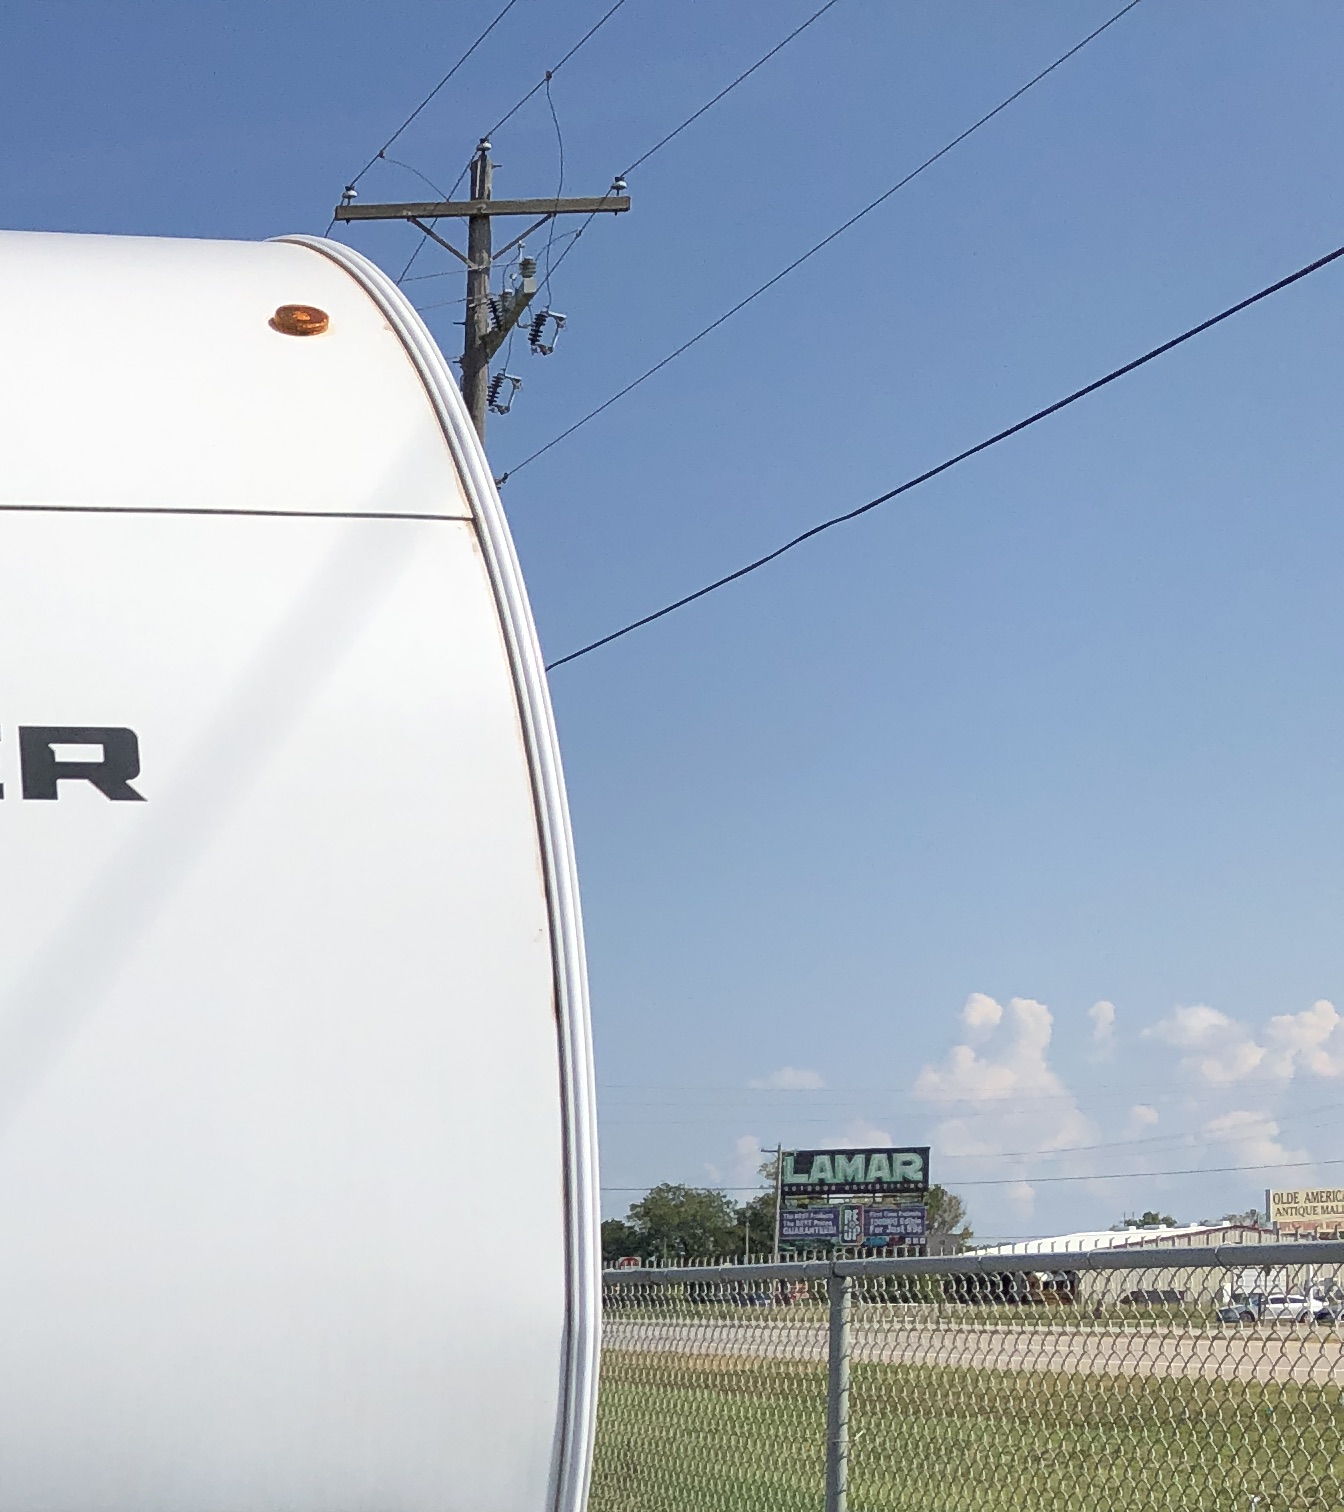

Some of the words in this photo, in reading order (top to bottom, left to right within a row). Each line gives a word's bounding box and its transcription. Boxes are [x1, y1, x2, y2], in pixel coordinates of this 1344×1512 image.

[784, 1153, 924, 1183] LAMAR
[1273, 1192, 1300, 1205] OLDE
[1275, 1205, 1318, 1217] ANTIQUE
[869, 1225, 884, 1235] For
[886, 1224, 905, 1234] Just
